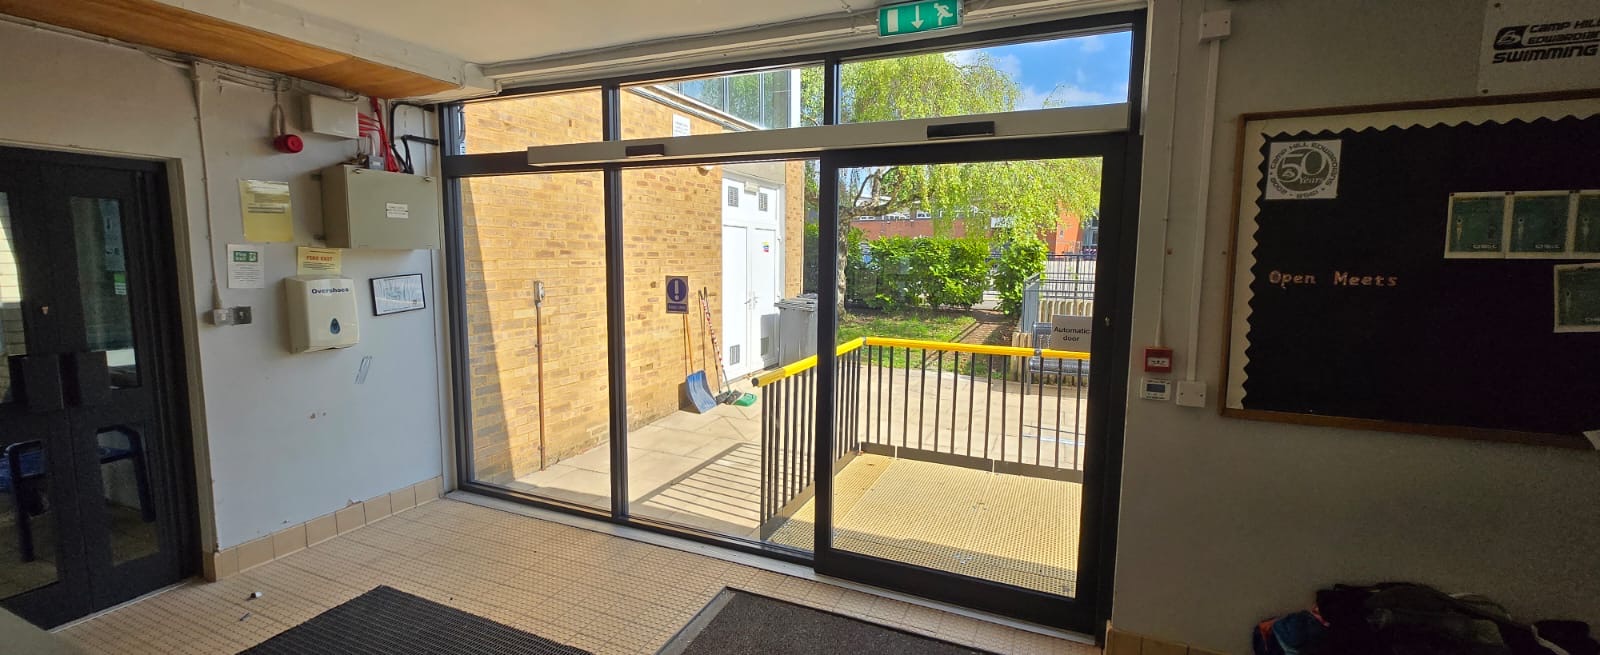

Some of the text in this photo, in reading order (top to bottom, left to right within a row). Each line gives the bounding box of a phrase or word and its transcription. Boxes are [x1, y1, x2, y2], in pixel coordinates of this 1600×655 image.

[1528, 31, 1600, 44] EDWARDIA
[1492, 44, 1599, 64] SWIMMING
[1280, 150, 1328, 183] 50
[1268, 269, 1398, 289] Open Meets
[1053, 326, 1091, 335] Automatic
